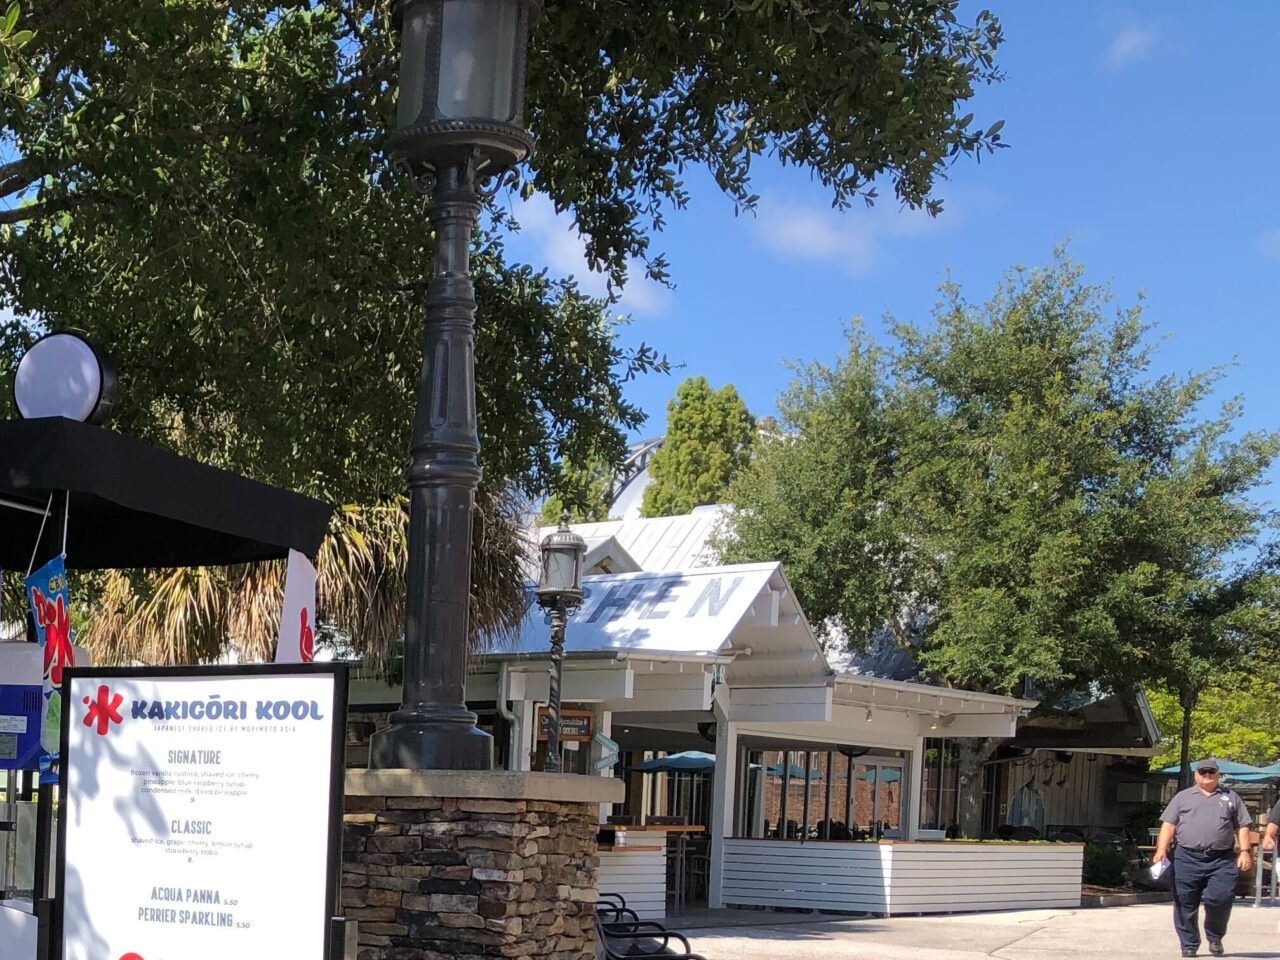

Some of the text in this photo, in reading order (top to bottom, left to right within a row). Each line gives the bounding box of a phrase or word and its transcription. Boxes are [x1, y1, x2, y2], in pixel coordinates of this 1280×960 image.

[255, 698, 325, 721] KOOL
[167, 749, 222, 766] SIGNATURE
[170, 818, 212, 836] CLASSIC
[151, 886, 183, 903] ACQUA
[186, 888, 221, 905] PANNA
[138, 907, 176, 924] PERRIER
[179, 910, 233, 928] SPARKLING
